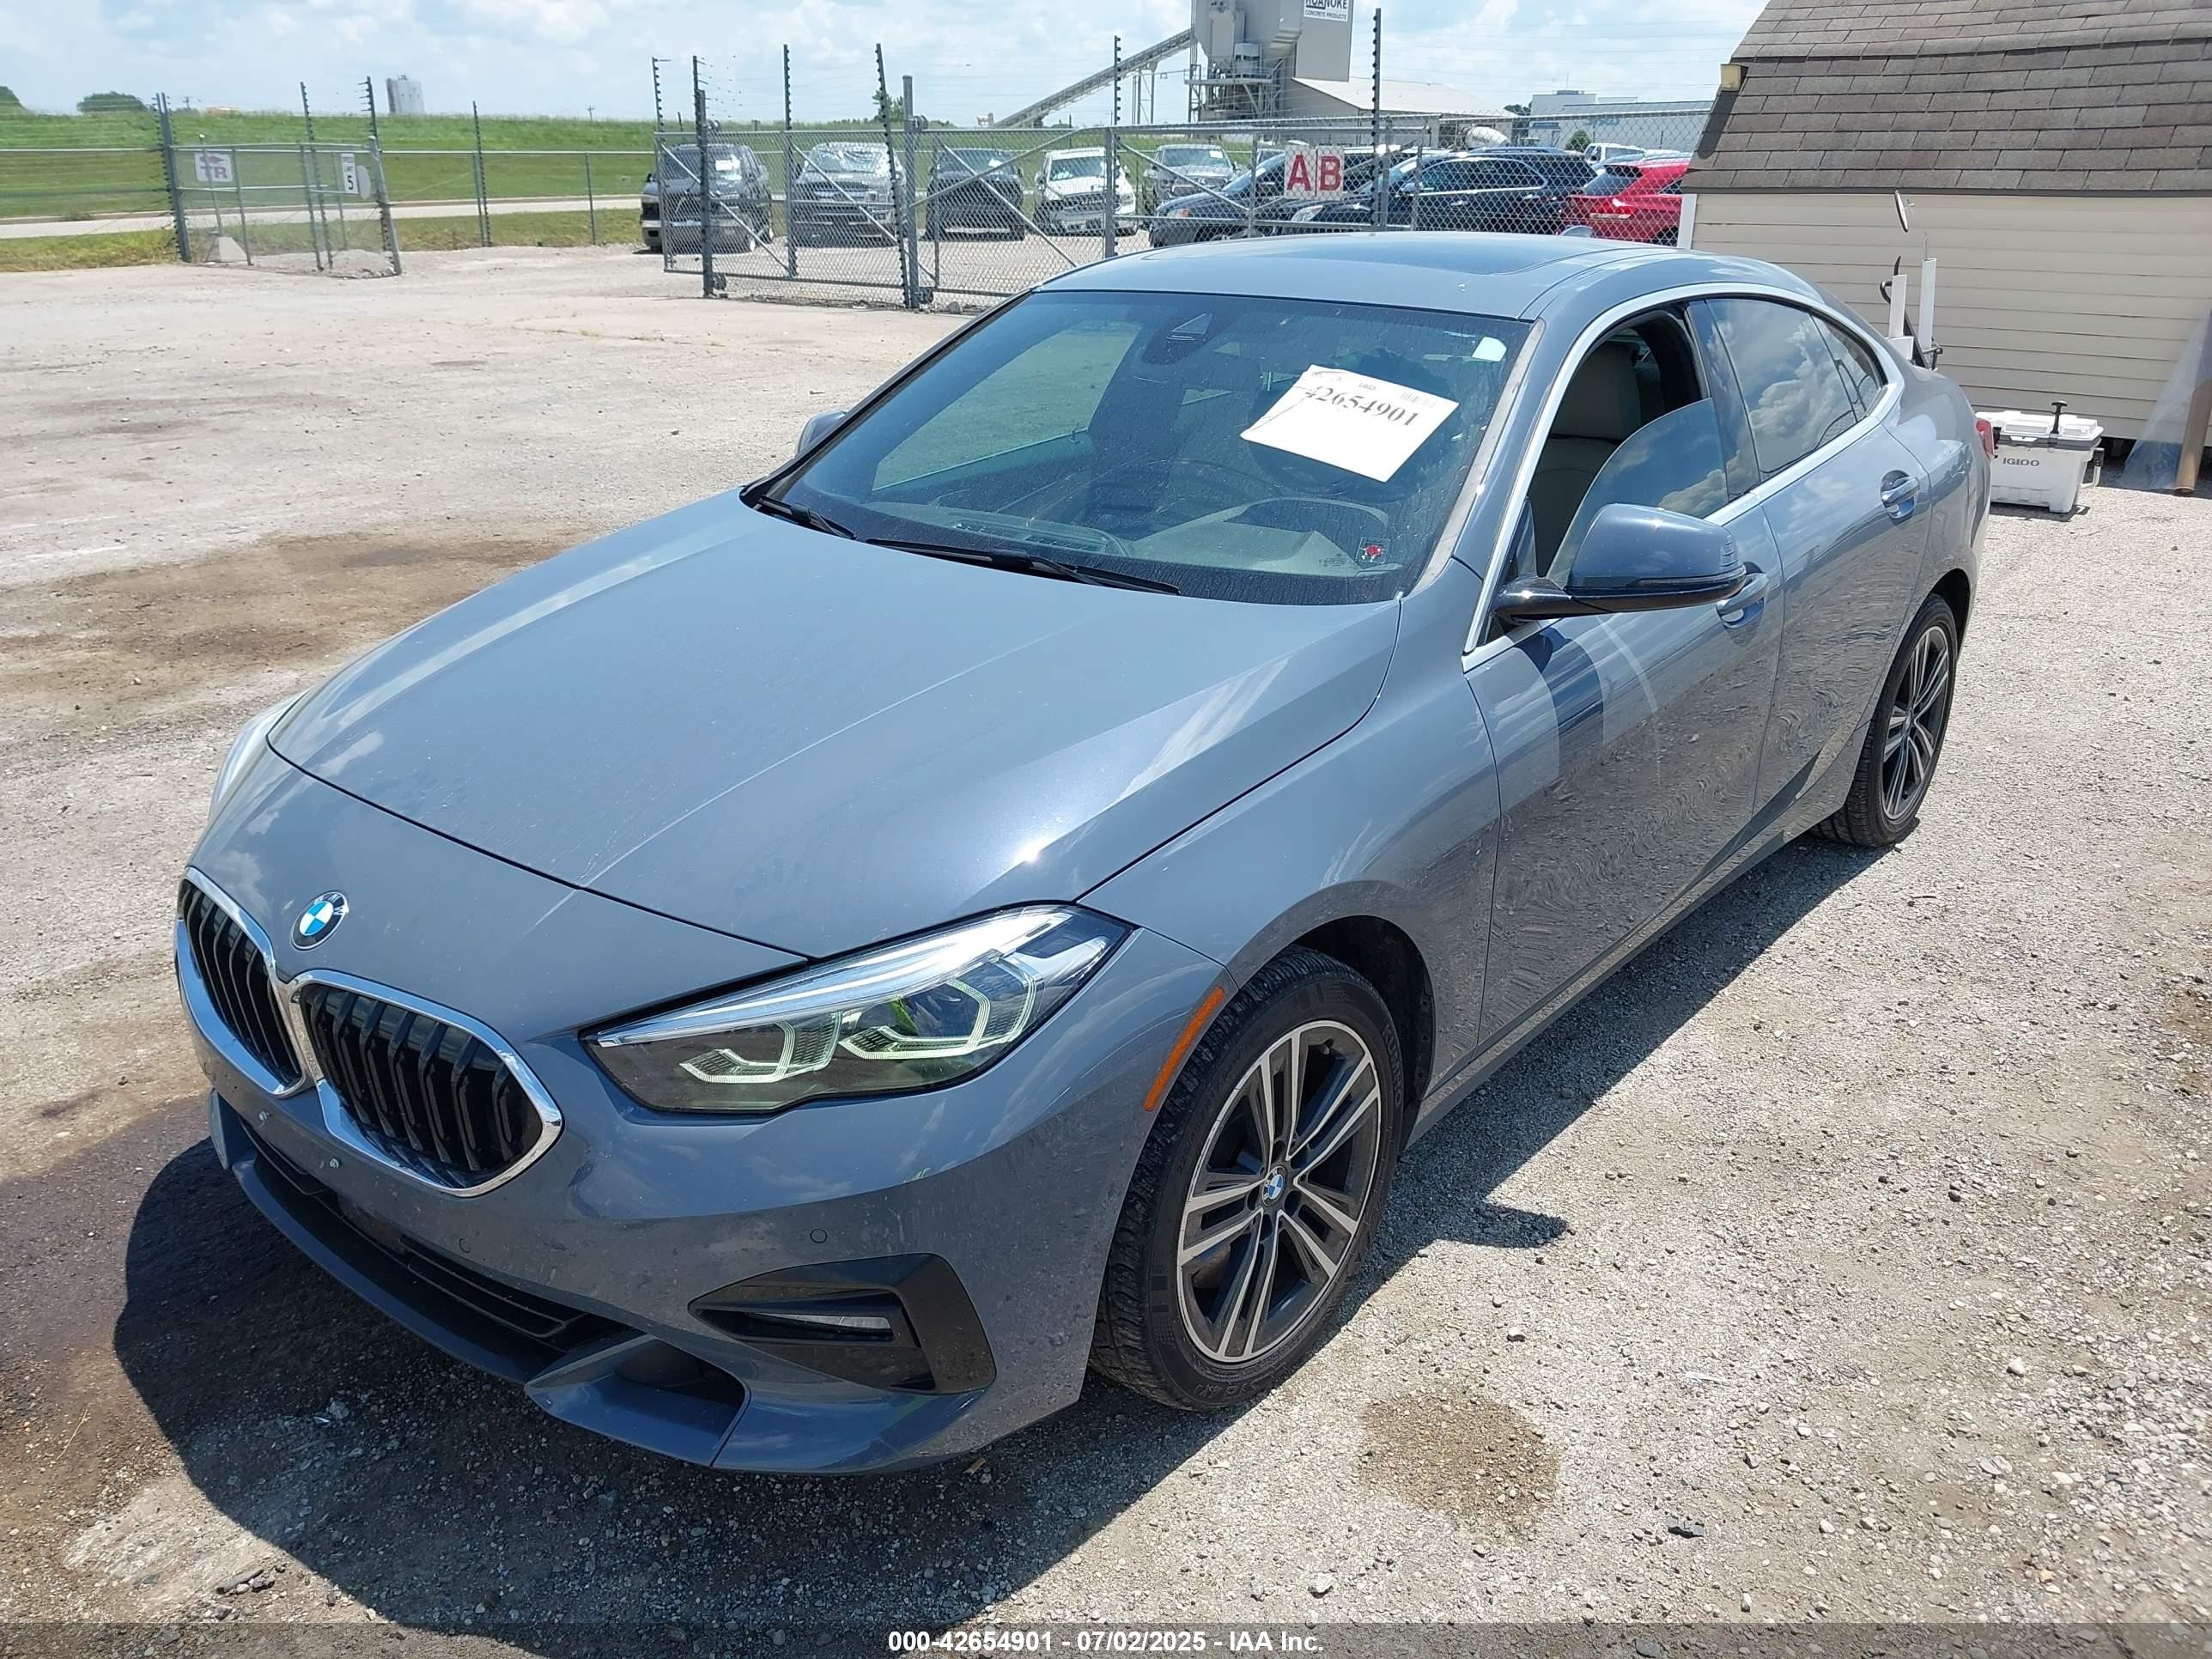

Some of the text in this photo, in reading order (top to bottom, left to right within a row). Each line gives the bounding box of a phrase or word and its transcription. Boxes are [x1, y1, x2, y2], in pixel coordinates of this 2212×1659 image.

[347, 174, 354, 191] 5
[1304, 386, 1419, 426] 42654901
[2002, 457, 2040, 467] IGLOO
